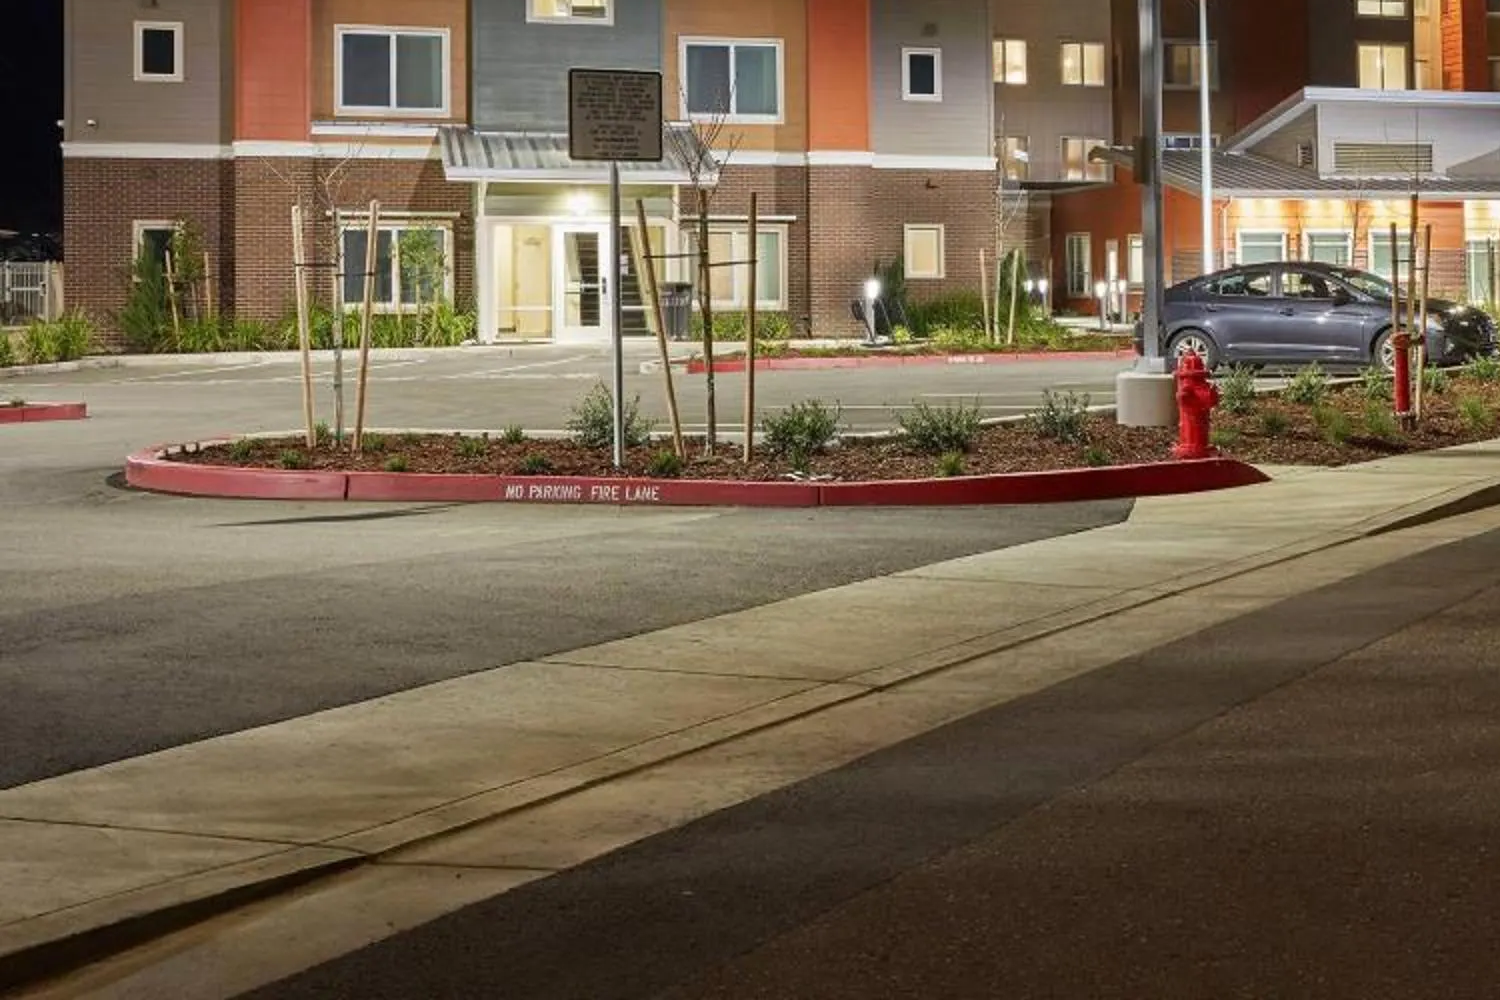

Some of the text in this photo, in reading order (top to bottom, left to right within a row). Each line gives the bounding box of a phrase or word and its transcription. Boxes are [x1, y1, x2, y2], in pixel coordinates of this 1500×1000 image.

[505, 485, 660, 501] NO PARKING FIRE LANE
